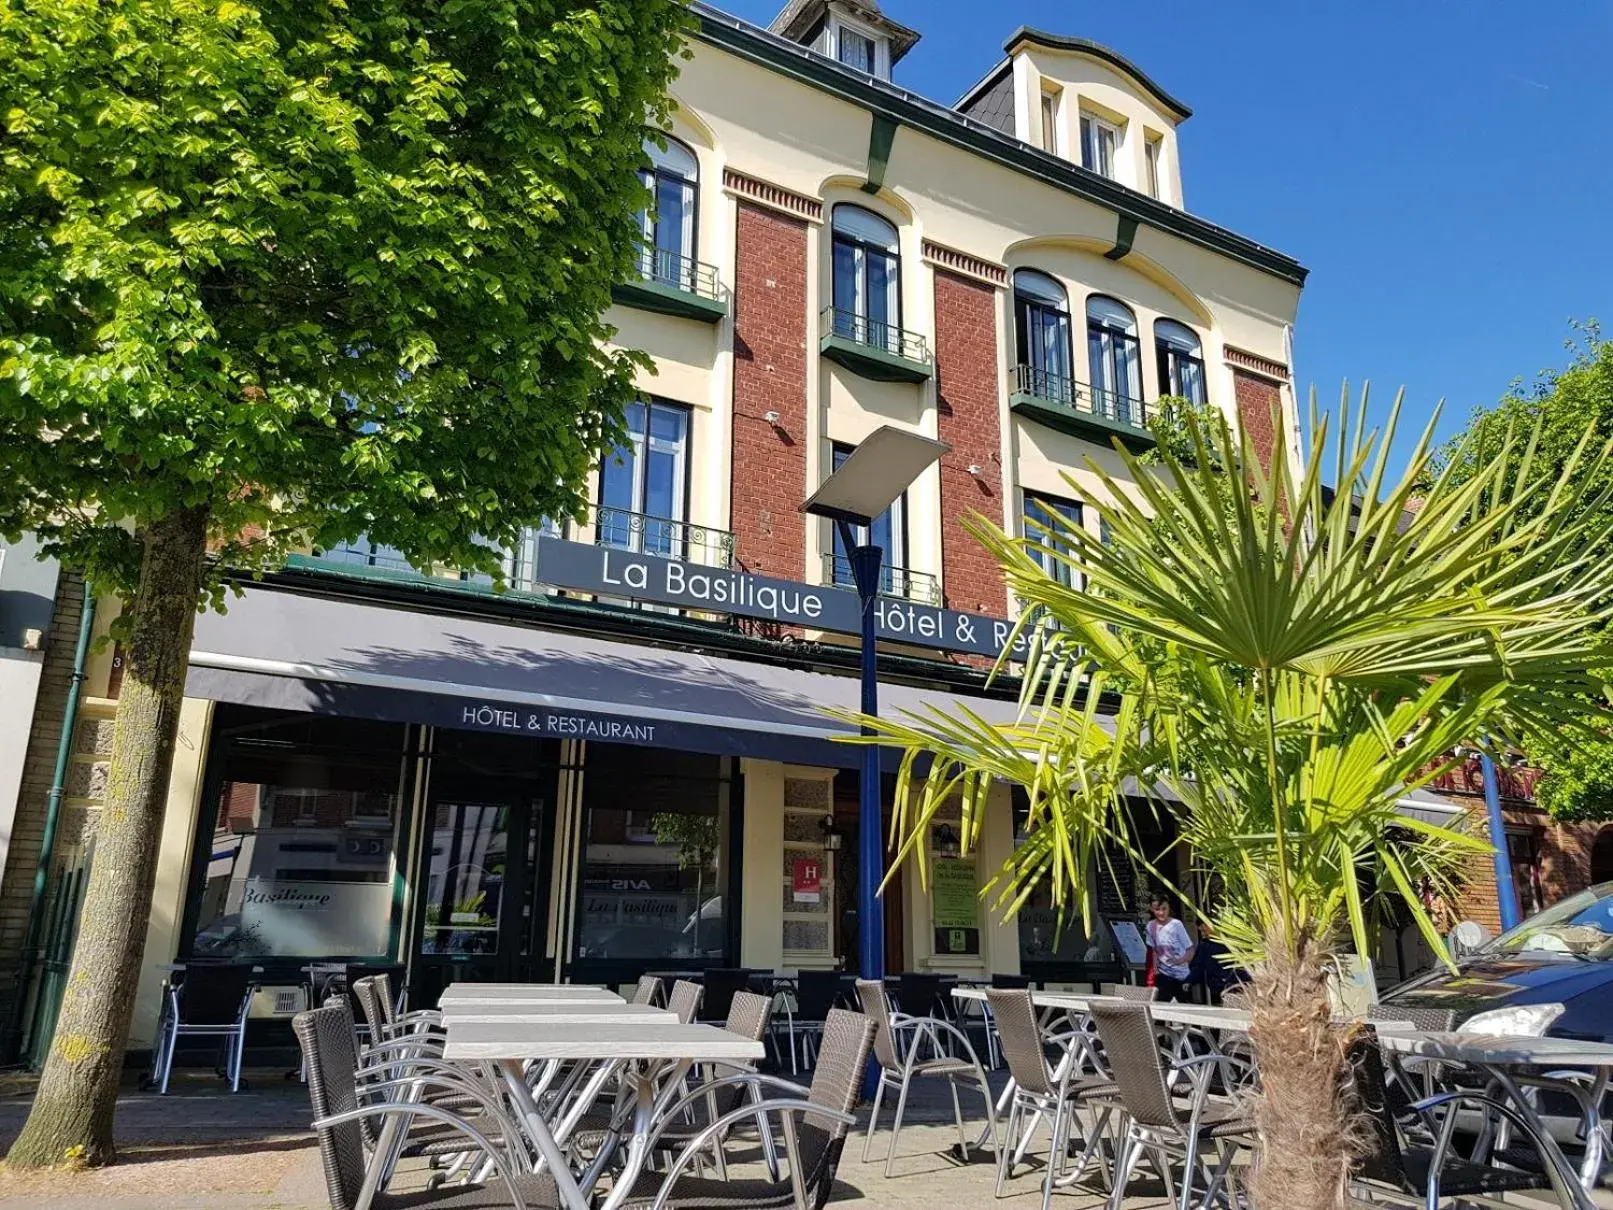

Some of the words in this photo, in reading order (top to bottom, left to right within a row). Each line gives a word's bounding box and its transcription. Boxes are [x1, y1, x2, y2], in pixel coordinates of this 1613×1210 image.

[602, 551, 648, 590] La
[666, 562, 822, 617] Basilique
[874, 600, 943, 639] Hôtel
[955, 614, 977, 644] &
[463, 705, 521, 729] HÔTEL
[527, 714, 541, 730] &
[547, 715, 655, 741] RESTAURANT
[805, 866, 817, 879] H
